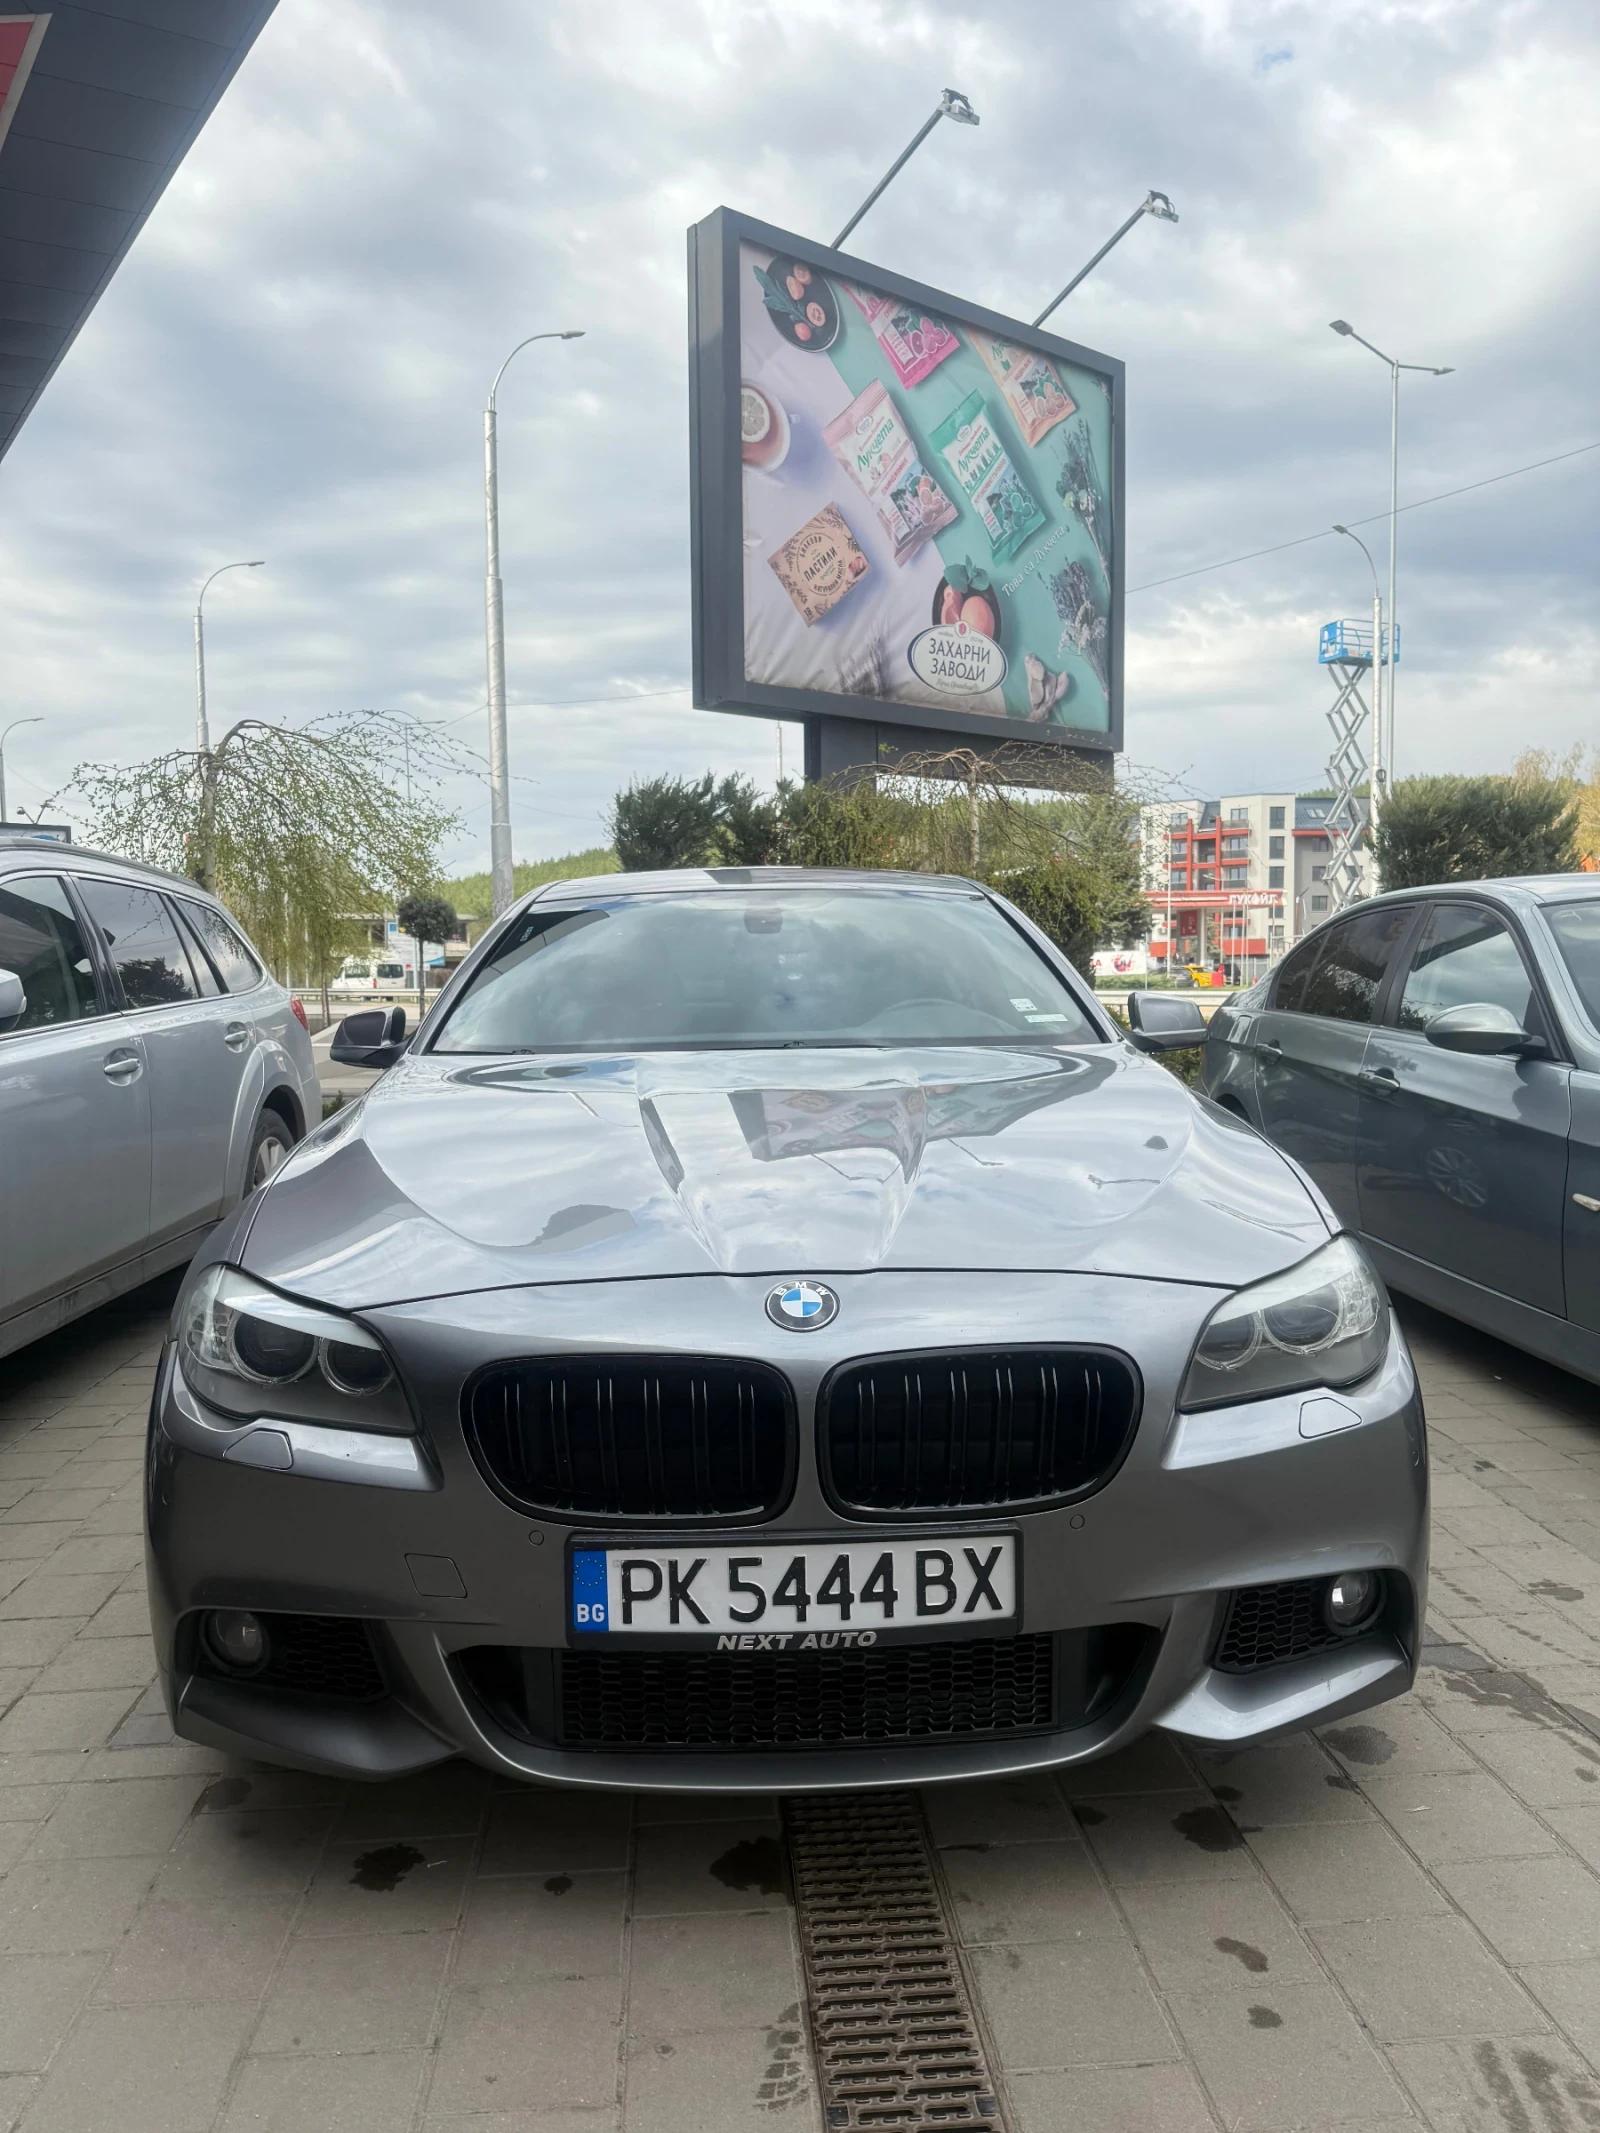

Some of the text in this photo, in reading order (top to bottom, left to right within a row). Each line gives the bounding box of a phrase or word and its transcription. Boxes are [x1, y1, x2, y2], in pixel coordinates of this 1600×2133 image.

[803, 546, 838, 581] ПАСТИЛИ
[929, 637, 991, 664] ЗАХАРНИ
[931, 658, 986, 682] ЗАВОДИ
[774, 1281, 829, 1296] BMW
[621, 1546, 1003, 1624] PK 5444 BX
[576, 1603, 605, 1623] BG
[717, 1631, 877, 1650] NEXT AUTO
